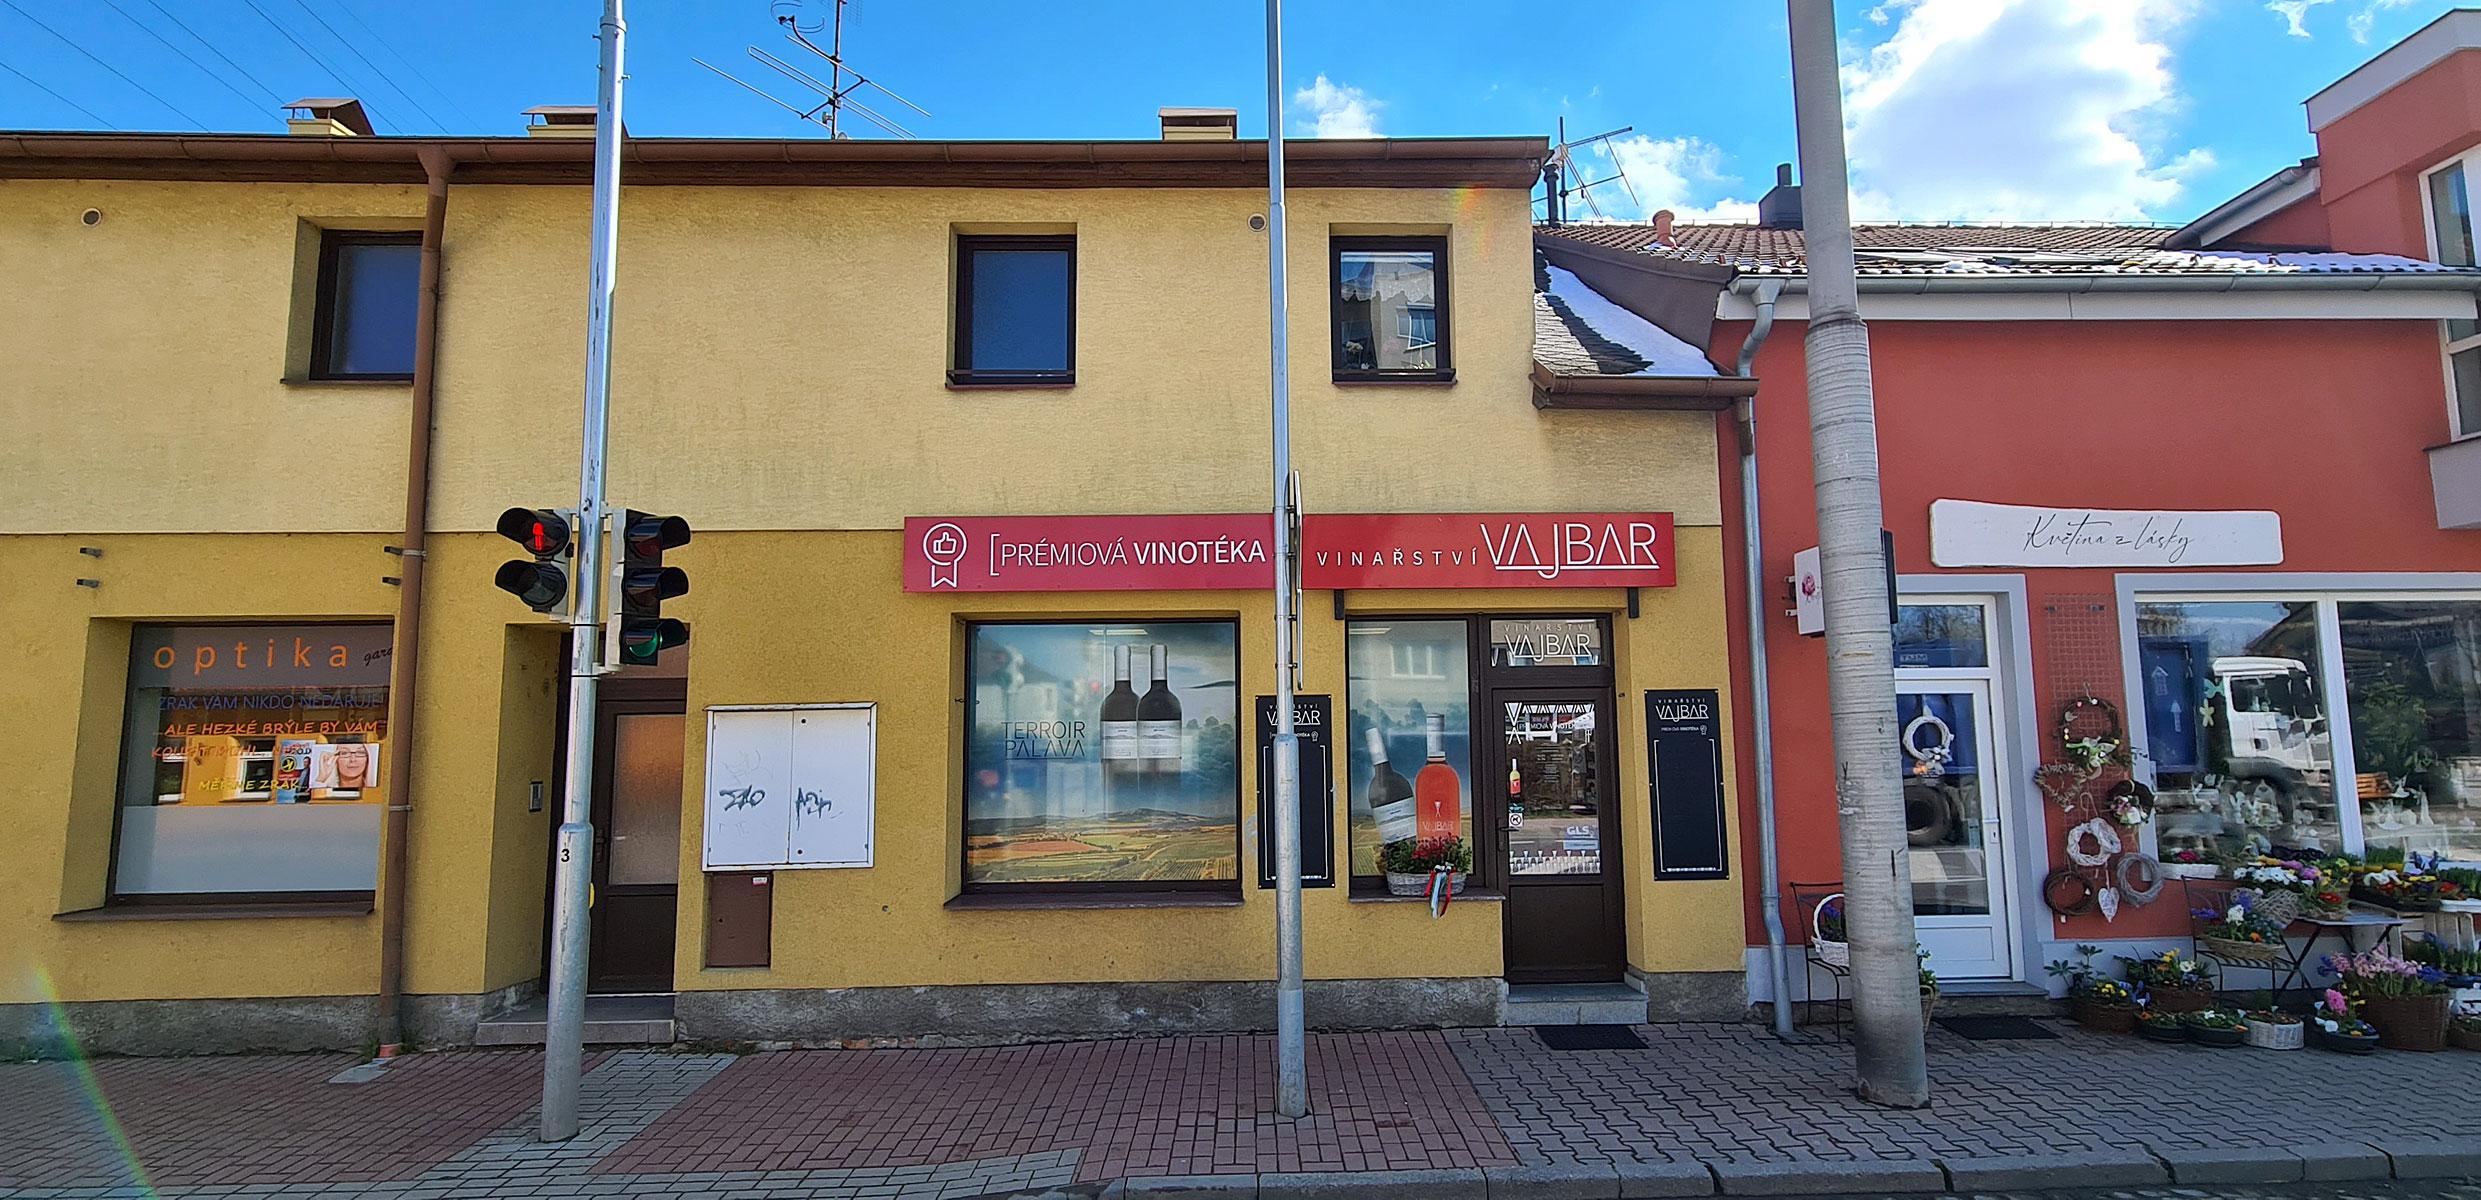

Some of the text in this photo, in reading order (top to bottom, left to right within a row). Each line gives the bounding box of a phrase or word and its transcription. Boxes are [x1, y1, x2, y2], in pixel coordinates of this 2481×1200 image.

[2024, 513, 2194, 564] Květina z lásky
[1133, 535, 1266, 565] VINOTÉKA
[1316, 523, 1660, 579] VINAŘSTVÍ VAJBAR
[153, 637, 349, 675] optika
[1505, 633, 1592, 662] VAJBAR
[159, 696, 198, 710] ZRAK
[243, 694, 295, 711] NIKDO
[1266, 710, 1321, 726] VBAR
[1655, 704, 1709, 722] VAJBAR
[164, 718, 378, 737] ALE HEZKÉ BRÝLE BY VÁM
[1001, 720, 1085, 739] TERROIR
[1566, 825, 1591, 835] GLS
[560, 848, 571, 863] 3
